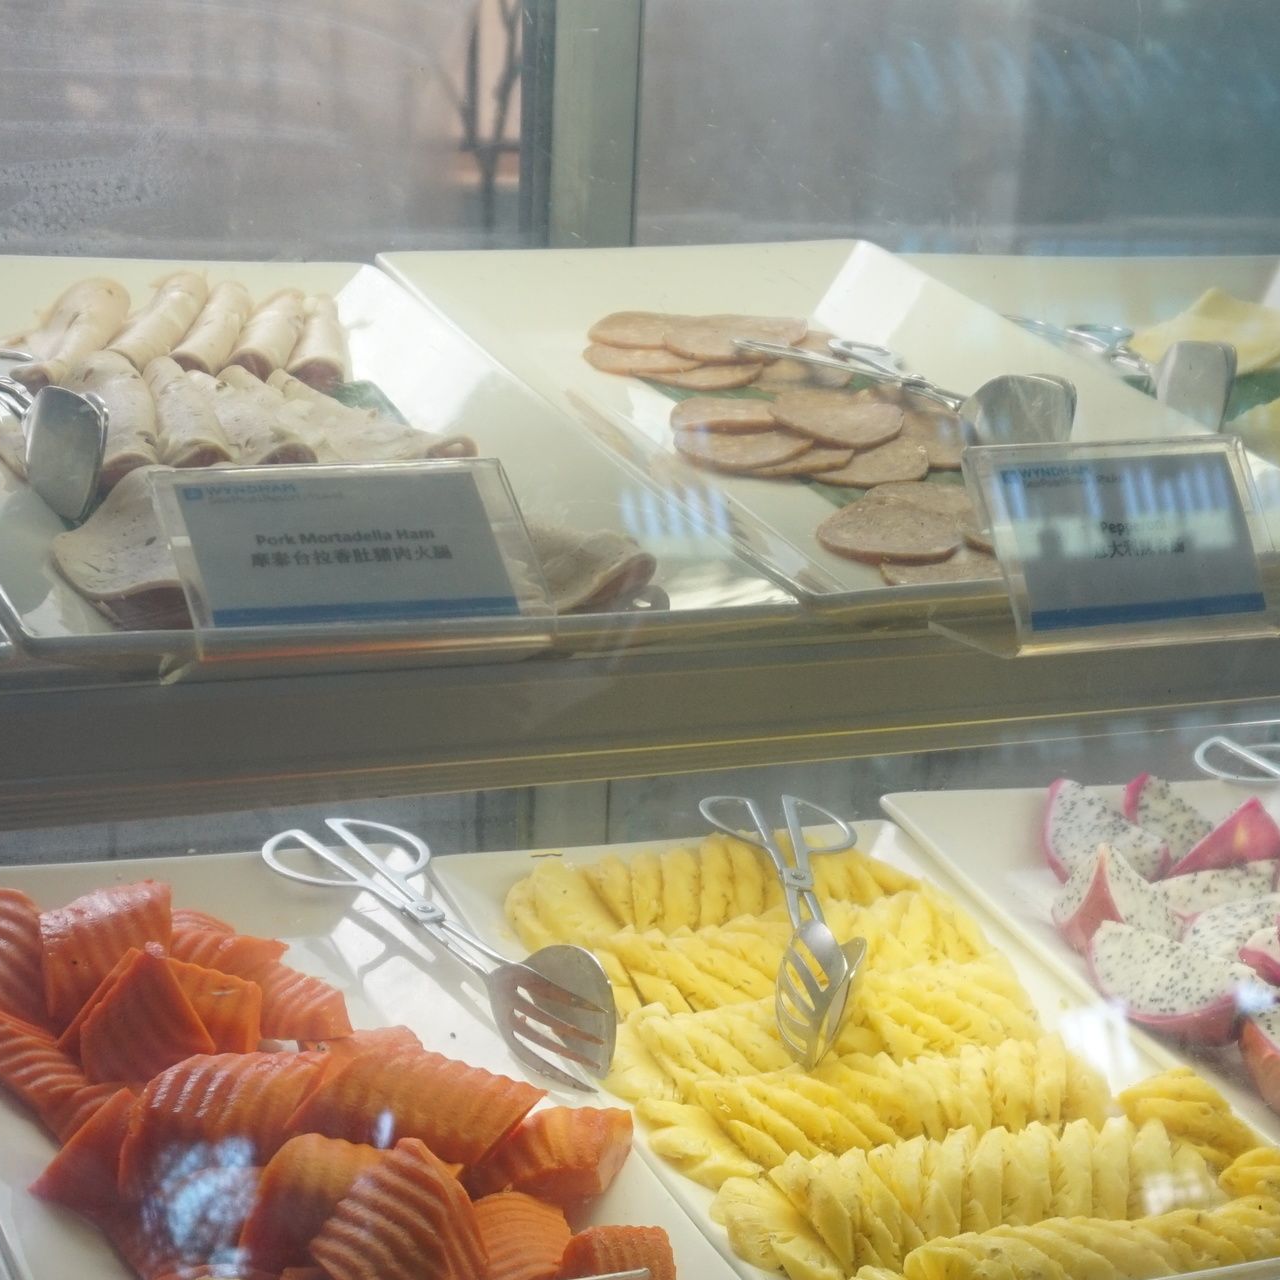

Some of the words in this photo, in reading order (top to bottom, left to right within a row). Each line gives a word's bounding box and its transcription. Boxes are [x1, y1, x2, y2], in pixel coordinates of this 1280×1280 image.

[256, 533, 297, 545] Pork
[299, 530, 392, 544] Mortadella
[396, 528, 436, 541] Ham
